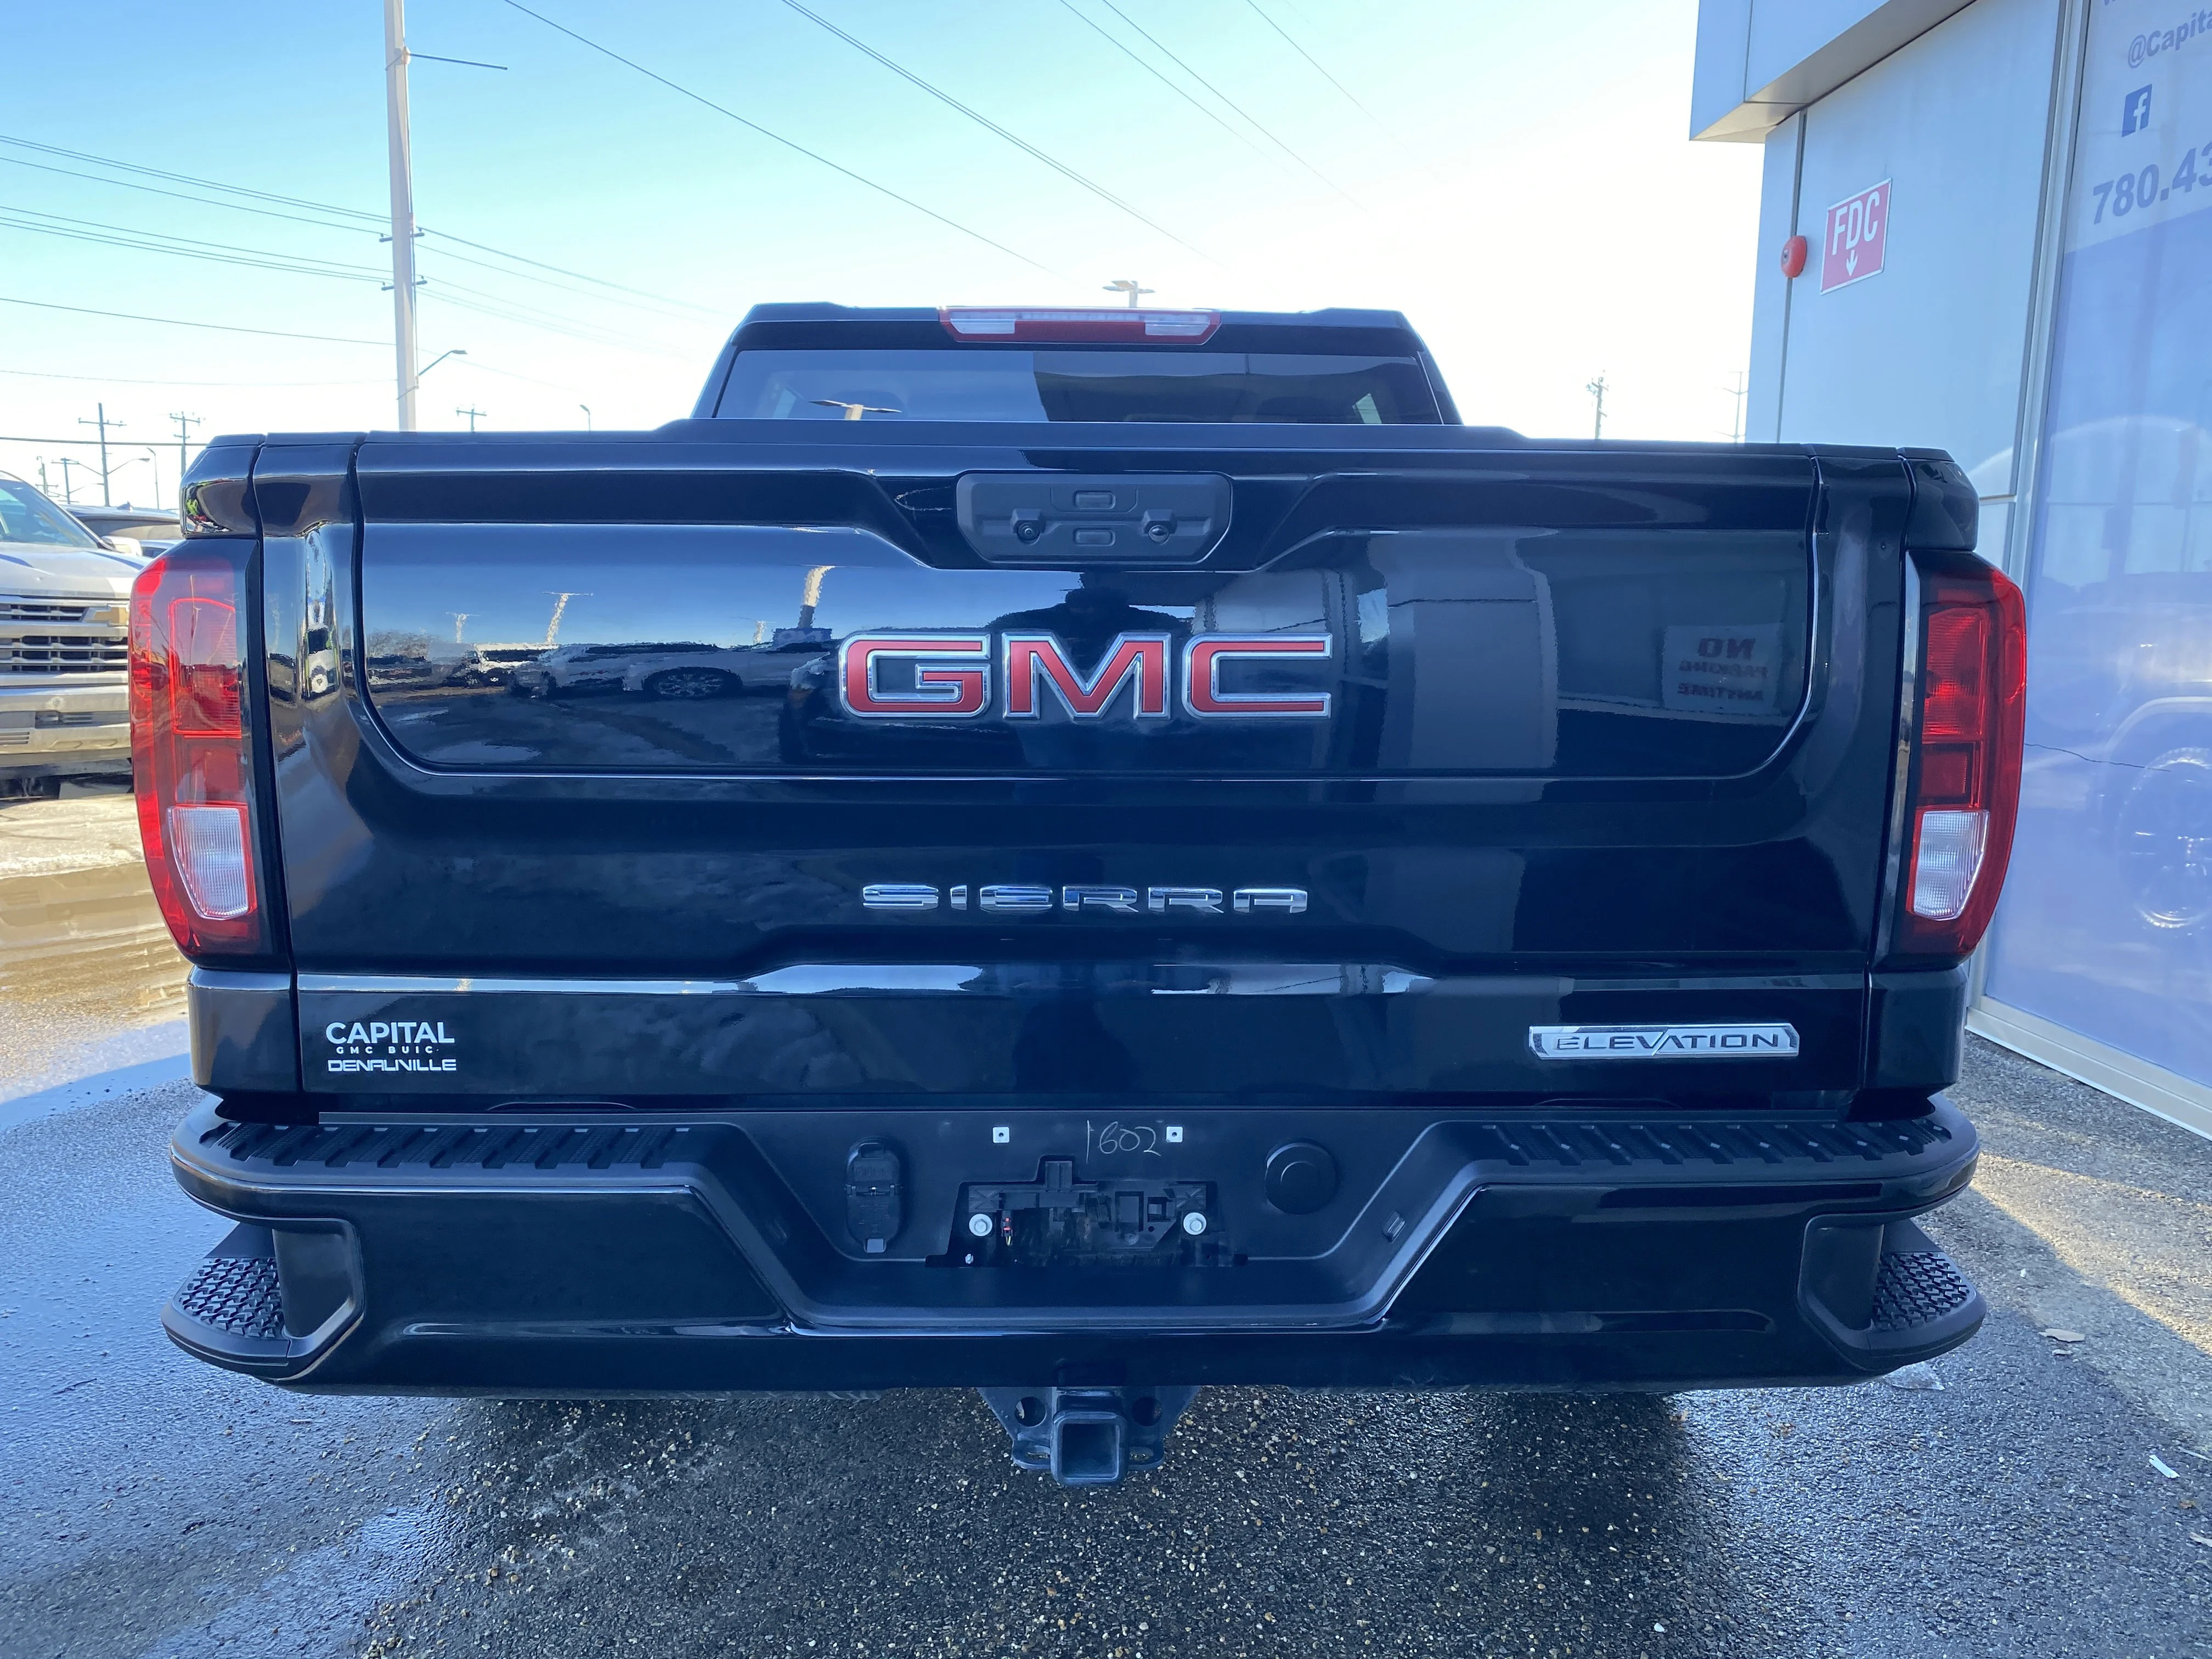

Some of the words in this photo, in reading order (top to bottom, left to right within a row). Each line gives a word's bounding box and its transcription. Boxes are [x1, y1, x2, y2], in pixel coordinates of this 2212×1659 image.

[1832, 191, 1880, 256] FDC
[839, 633, 1333, 721] GMC
[862, 884, 1308, 913] SIERRA
[326, 1022, 455, 1044] CAPITAL
[1555, 1032, 1779, 1050] ELEVATION
[336, 1046, 373, 1054] GMC
[388, 1046, 439, 1054] BUIC
[1086, 1120, 1161, 1164] 1602
